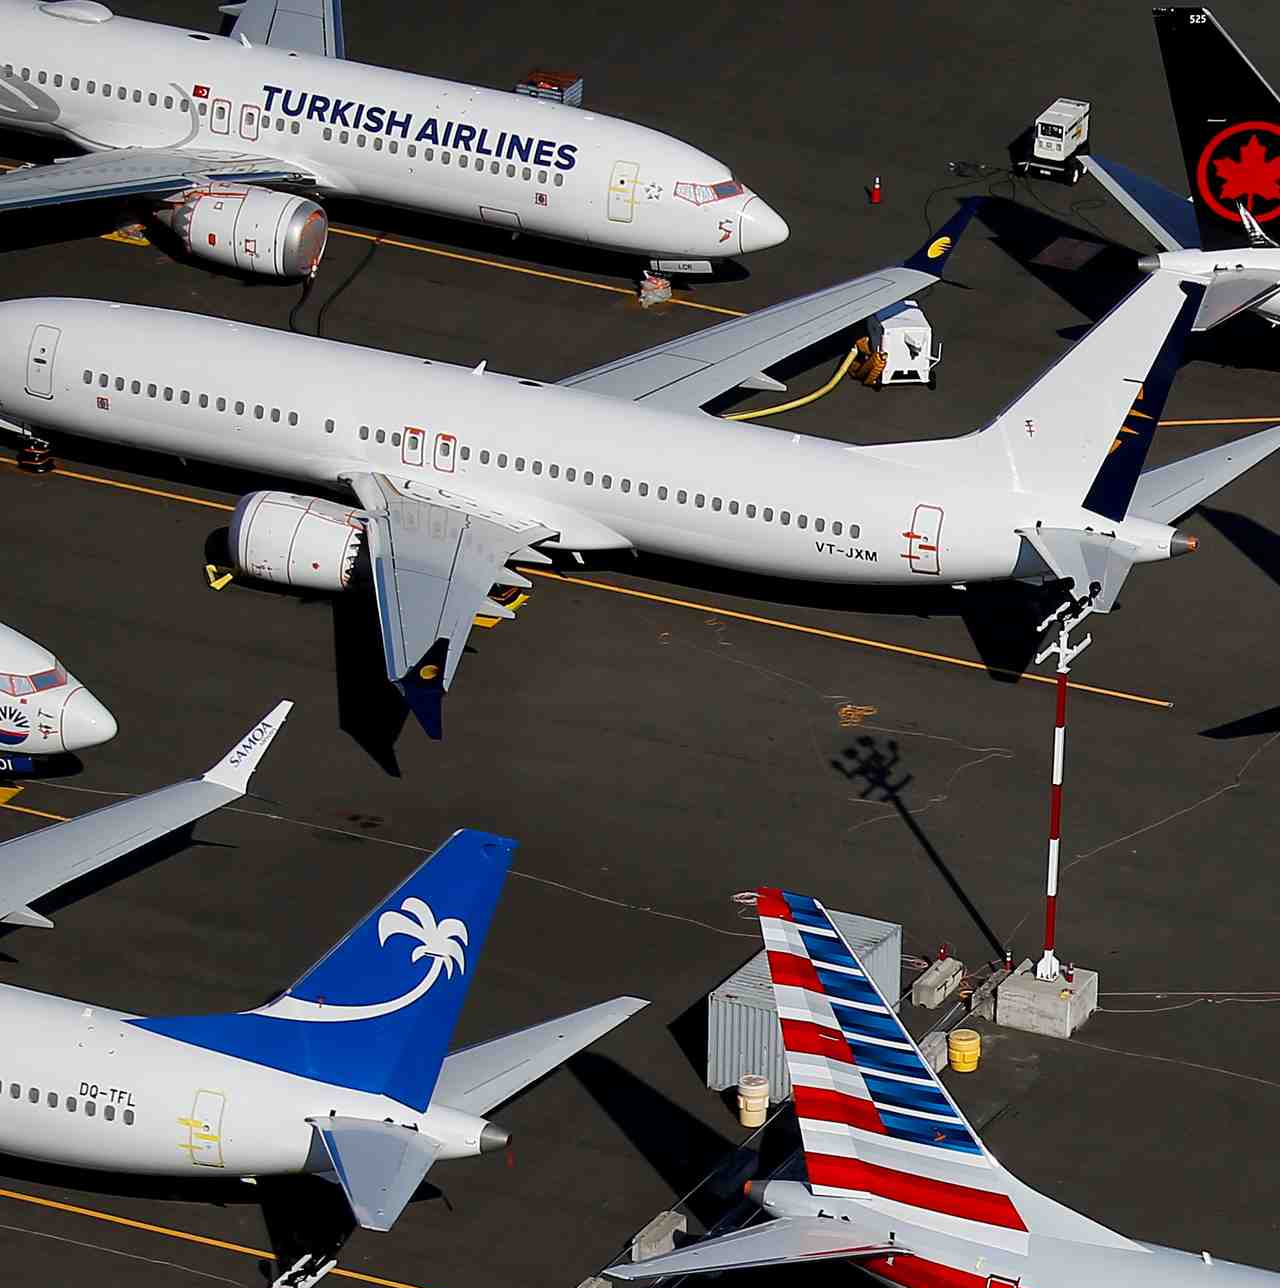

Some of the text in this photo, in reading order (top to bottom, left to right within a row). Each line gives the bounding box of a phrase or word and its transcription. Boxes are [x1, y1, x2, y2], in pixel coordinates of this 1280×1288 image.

[1189, 14, 1207, 24] 525
[262, 84, 578, 171] TURKISH AIRLINES
[815, 541, 878, 562] VT-JXM
[228, 721, 274, 768] SAMOA
[79, 1081, 136, 1108] DQ-TFL
